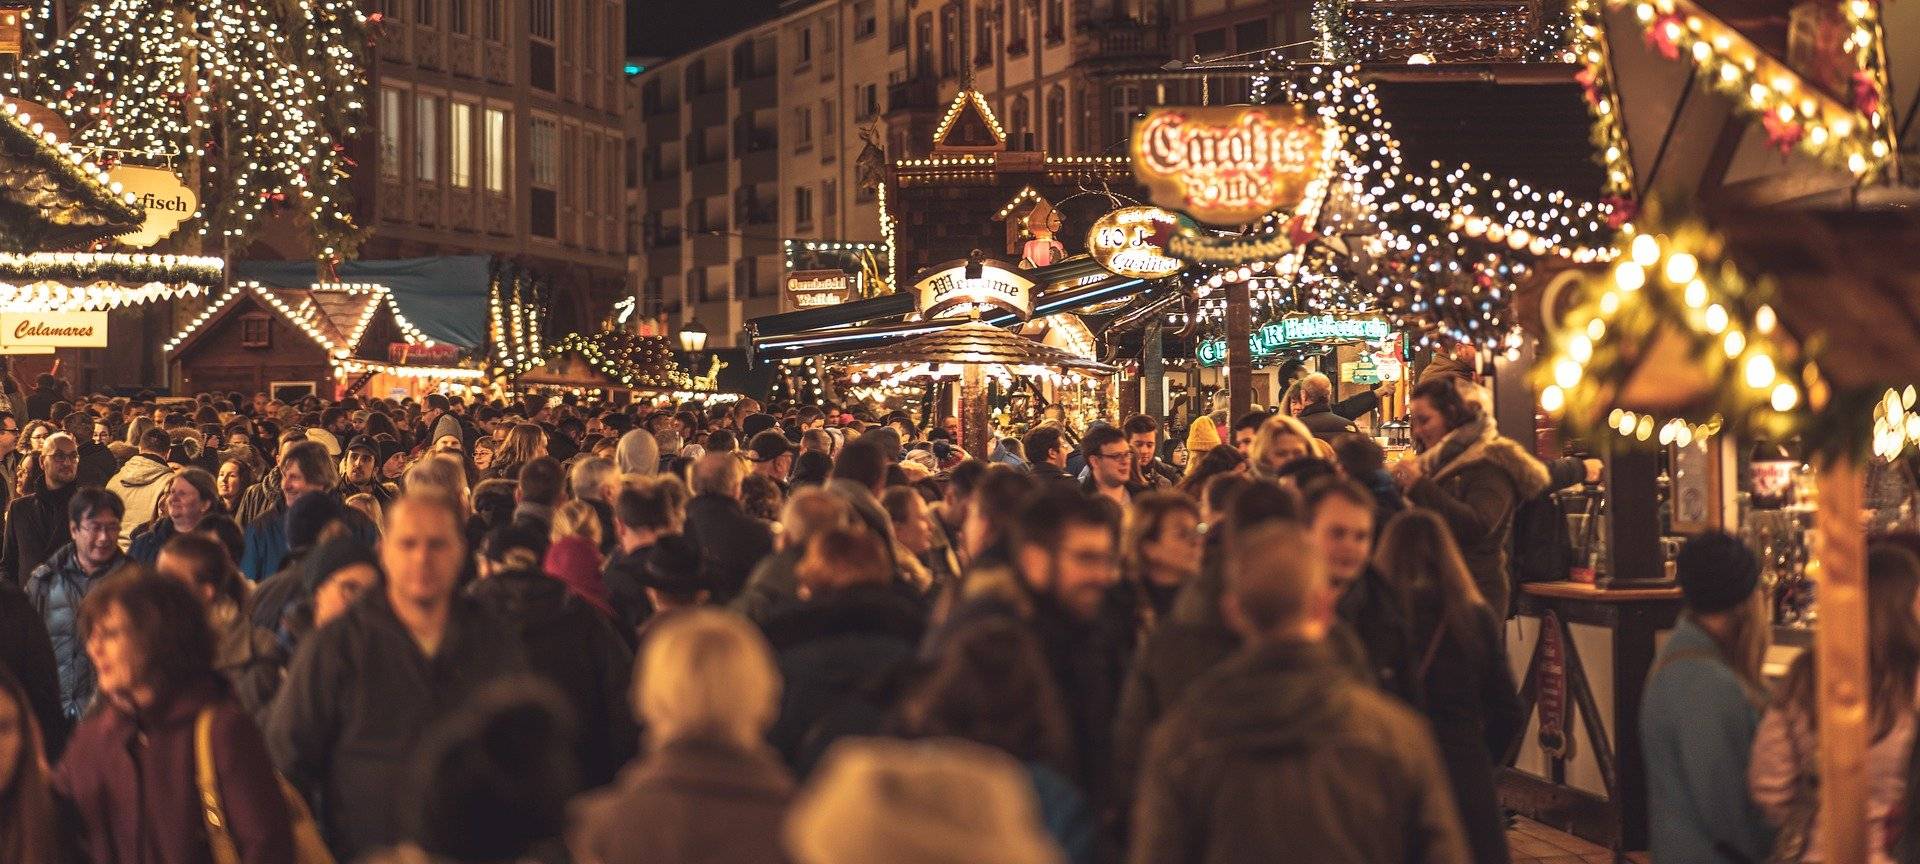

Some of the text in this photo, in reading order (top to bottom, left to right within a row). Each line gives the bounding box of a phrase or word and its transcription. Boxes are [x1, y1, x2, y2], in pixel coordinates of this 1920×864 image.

[135, 192, 187, 212] fisch
[928, 273, 1019, 303] Weme
[14, 320, 93, 339] Calamares
